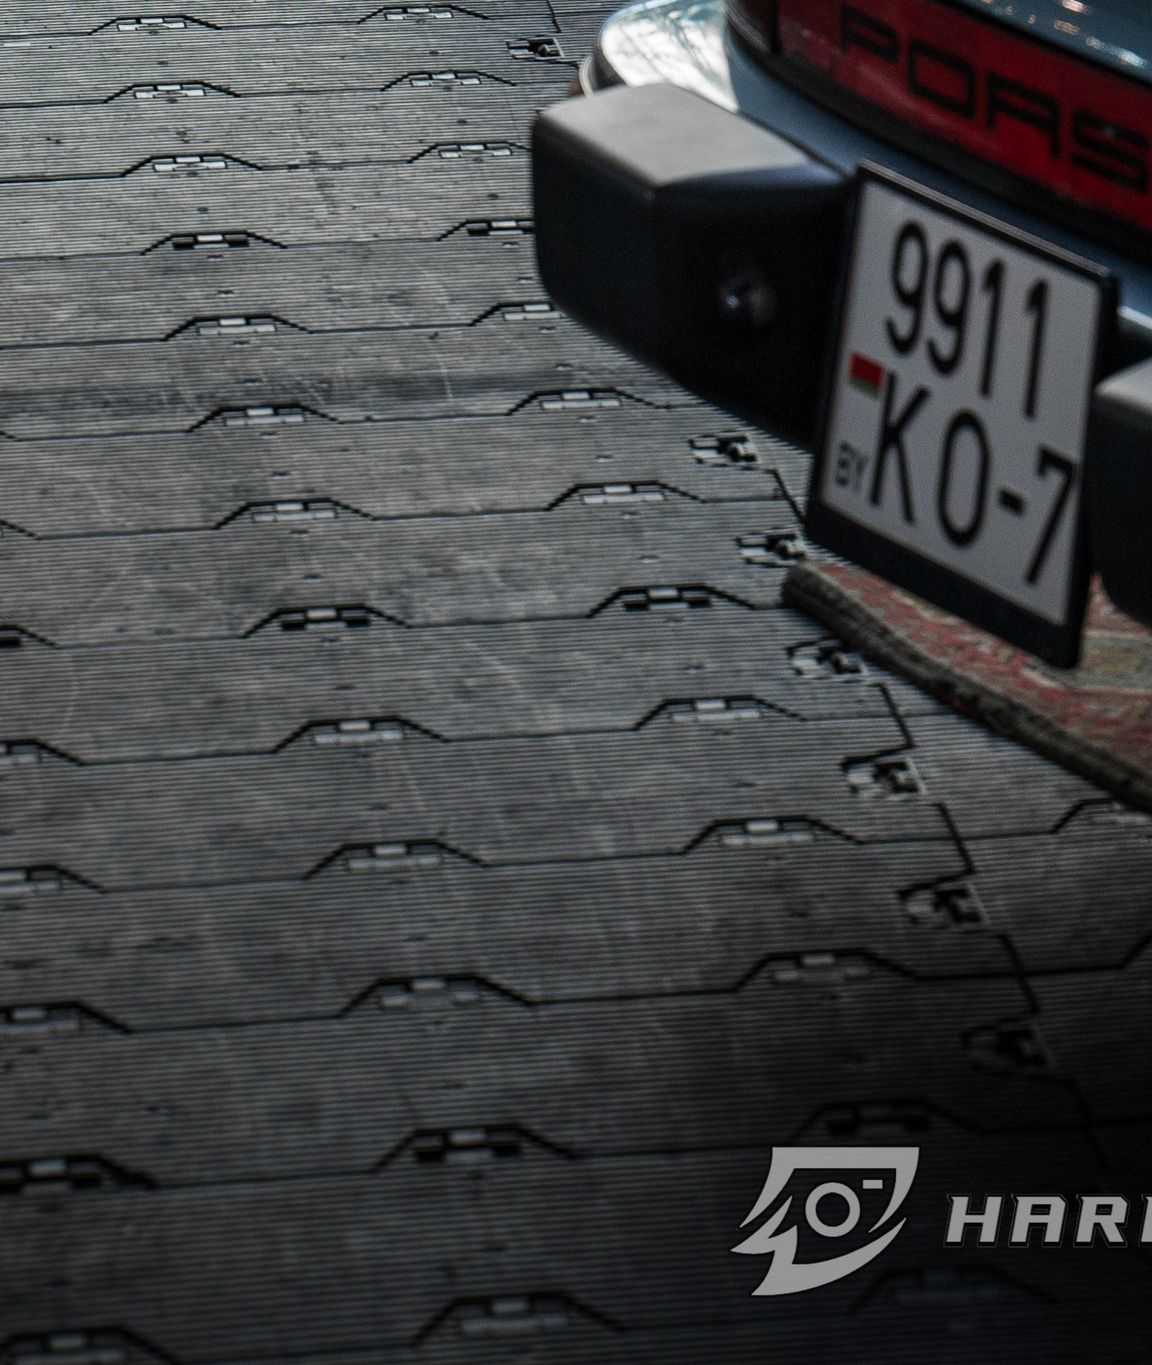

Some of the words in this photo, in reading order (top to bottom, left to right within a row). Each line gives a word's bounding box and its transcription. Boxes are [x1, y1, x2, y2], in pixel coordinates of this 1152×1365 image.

[886, 219, 1048, 419] 9911
[836, 443, 865, 491] BY
[870, 372, 1076, 585] KO-7
